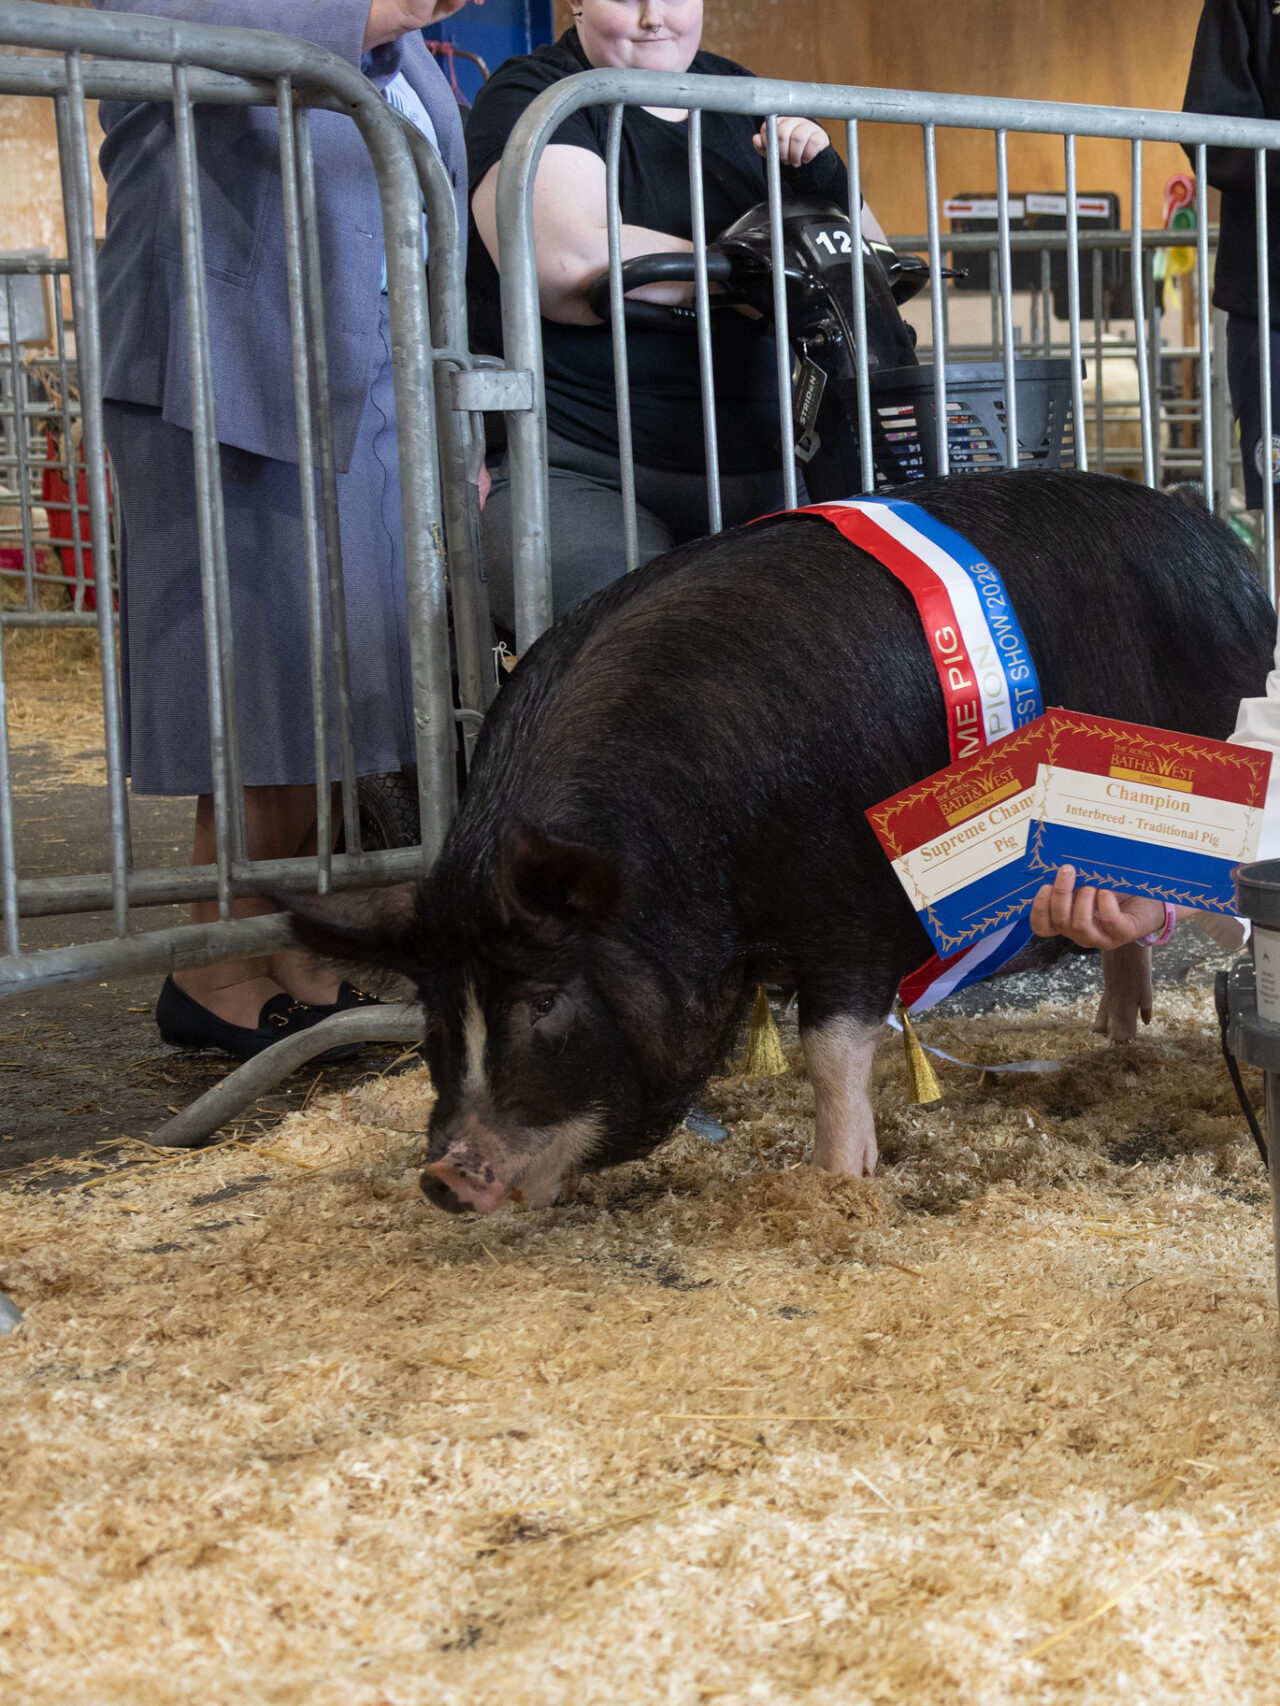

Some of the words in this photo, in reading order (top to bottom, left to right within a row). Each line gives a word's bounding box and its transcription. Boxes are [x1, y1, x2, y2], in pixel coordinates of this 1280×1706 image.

[969, 562, 1005, 608] 2026
[935, 626, 972, 691] PIG
[990, 615, 1030, 681] SHOW
[1105, 782, 1191, 813] Champion
[920, 821, 987, 862] Supreme
[988, 793, 1035, 825] Cham
[993, 835, 1018, 854] Pig
[1066, 803, 1126, 826] Interbreed
[1136, 817, 1199, 841] Traditional
[1201, 831, 1221, 848] Pig
